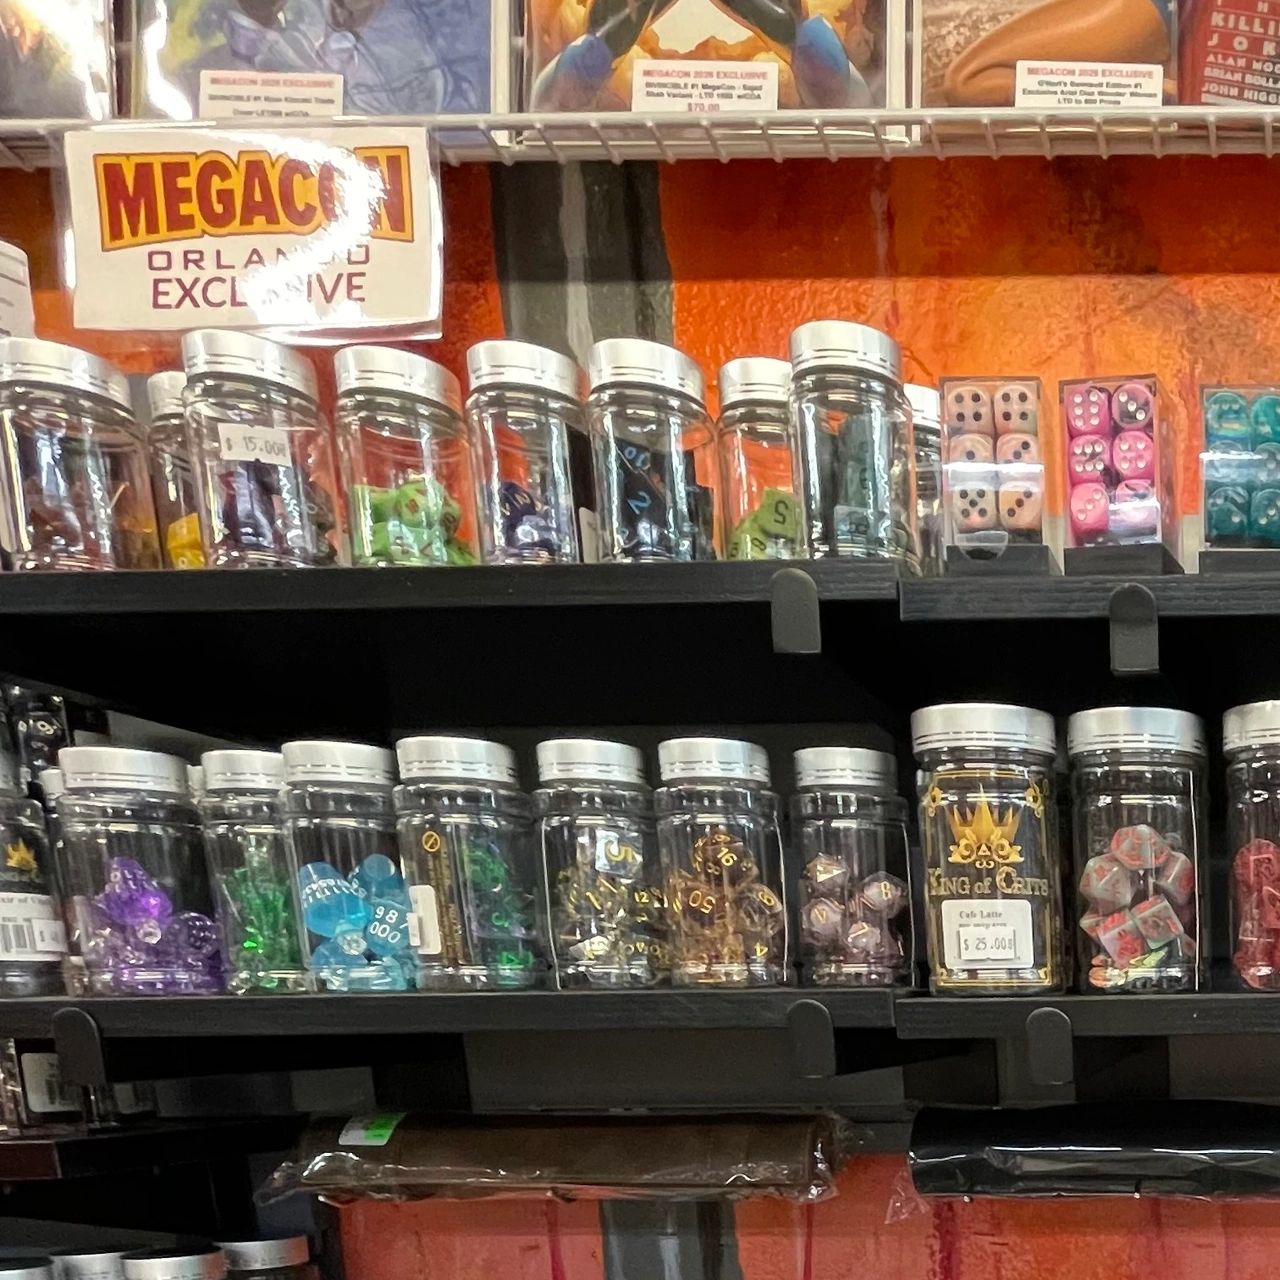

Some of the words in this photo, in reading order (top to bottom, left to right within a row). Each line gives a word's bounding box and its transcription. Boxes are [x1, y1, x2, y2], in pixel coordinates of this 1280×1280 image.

[1206, 54, 1246, 67] ALAN
[643, 70, 690, 78] MEGACON
[716, 71, 767, 79] EXCLUSIVE
[1201, 82, 1238, 96] JOHN
[148, 246, 370, 271] ORLAO
[152, 272, 366, 309] EXCLIVE
[974, 877, 992, 894] of
